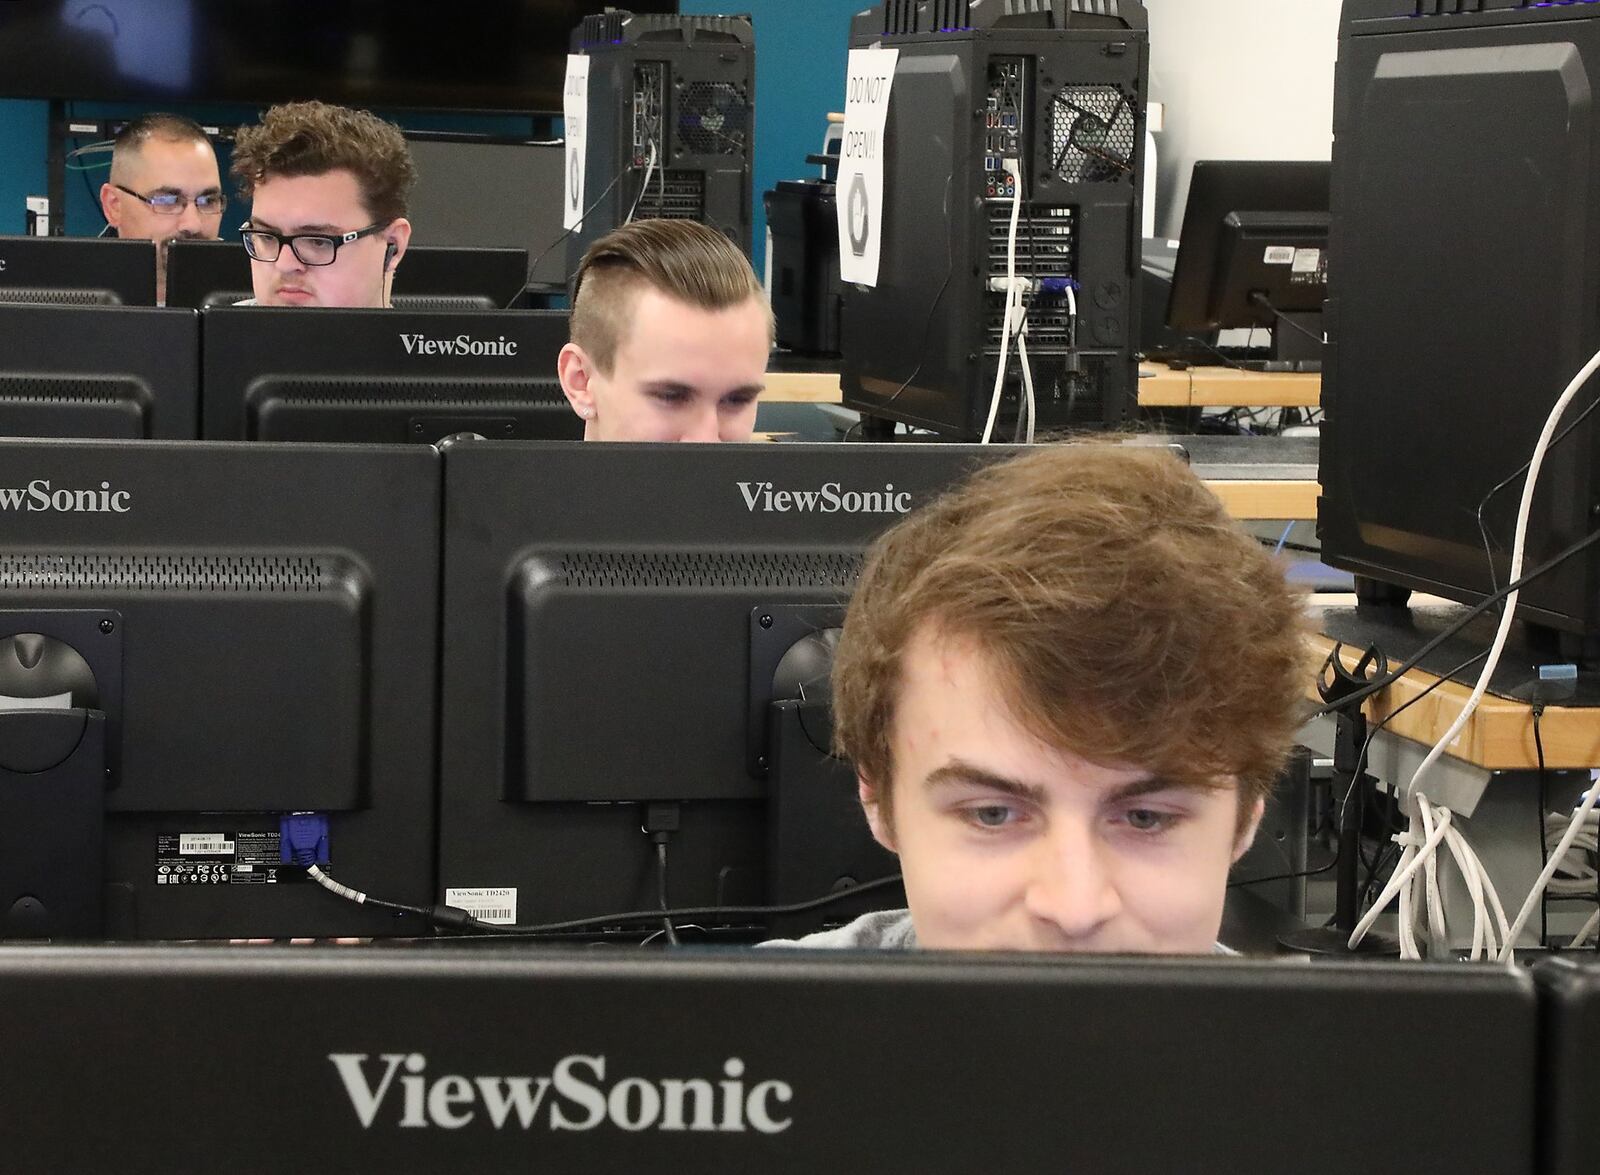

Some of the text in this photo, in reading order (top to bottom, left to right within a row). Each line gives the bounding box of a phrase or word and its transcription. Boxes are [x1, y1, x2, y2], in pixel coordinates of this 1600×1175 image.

[850, 77, 887, 103] DO NOT
[846, 131, 876, 159] OPEN!!
[399, 334, 517, 356] ViewSonic
[736, 482, 912, 513] ViewSonic
[328, 1053, 793, 1133] ViewSonic
